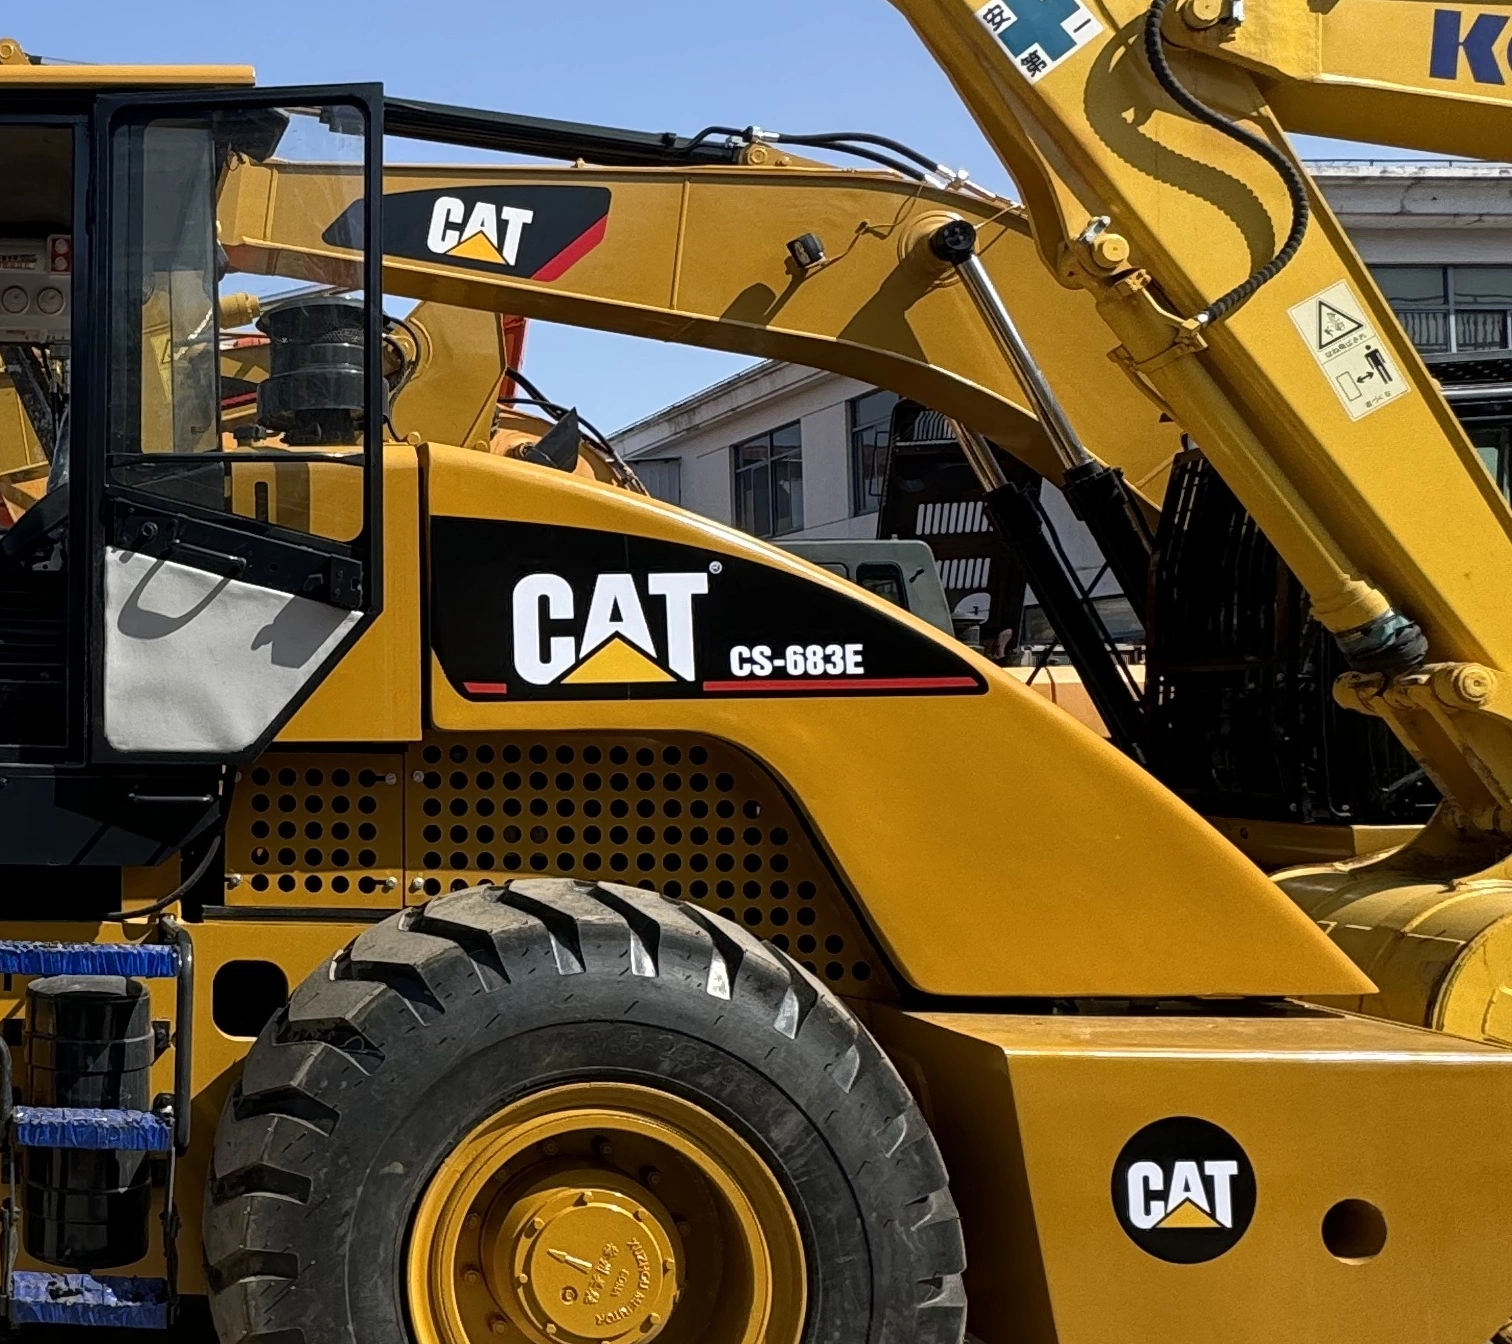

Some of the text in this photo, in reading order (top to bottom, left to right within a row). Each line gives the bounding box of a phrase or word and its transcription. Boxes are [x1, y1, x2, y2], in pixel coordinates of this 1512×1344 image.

[1429, 8, 1512, 86] K
[426, 196, 534, 266] CAT
[512, 572, 865, 685] CAT CS-683E
[1127, 1160, 1238, 1230] CAT
